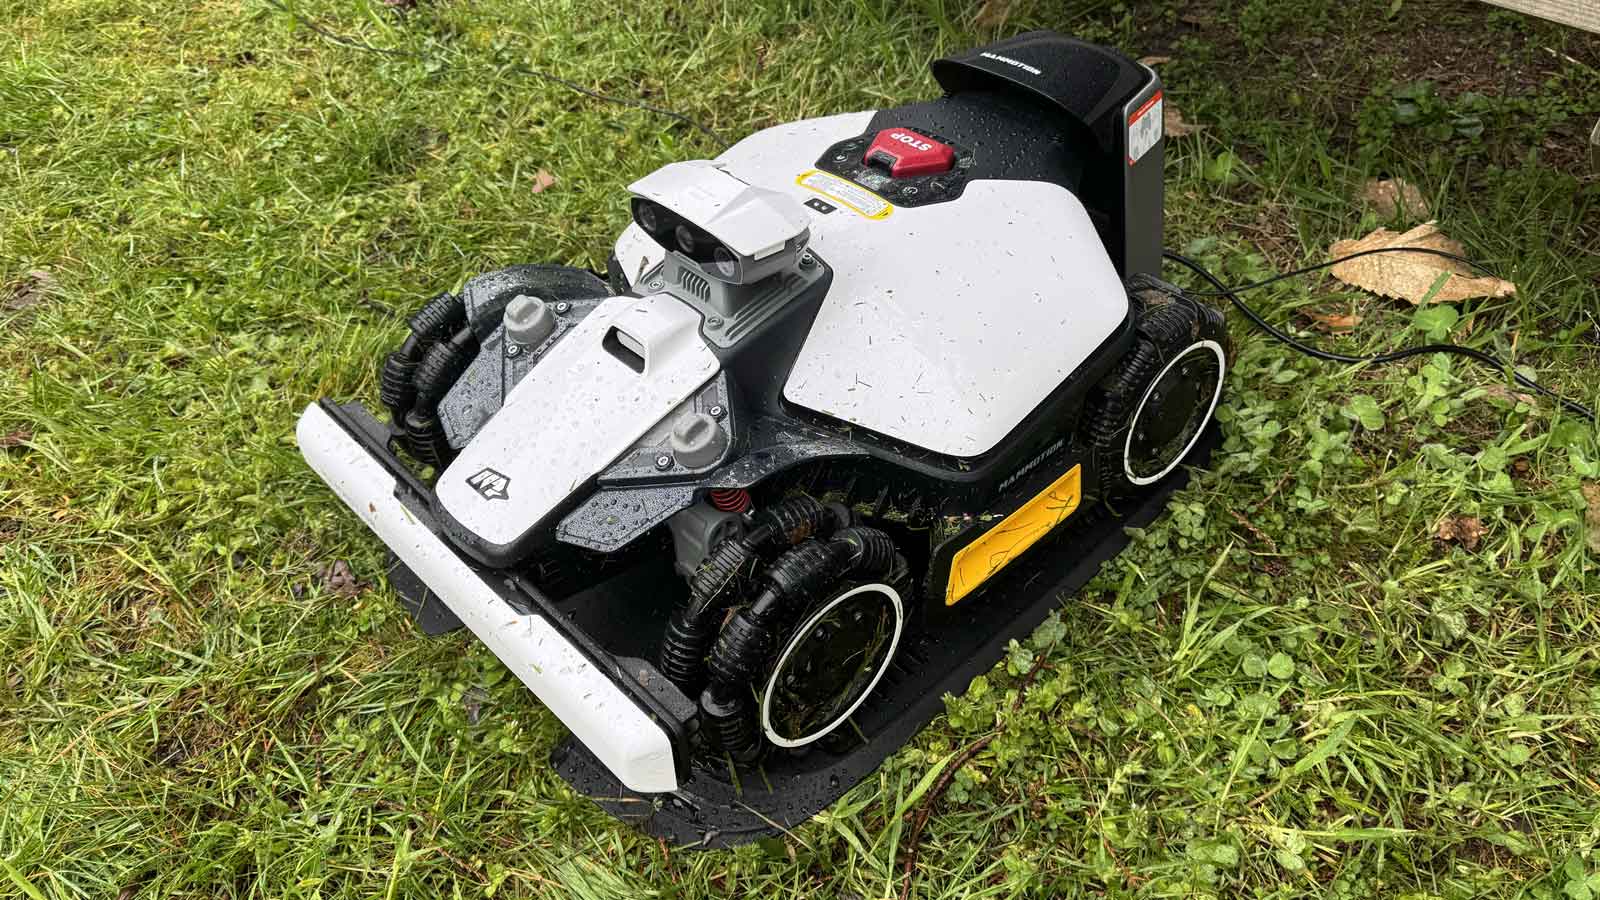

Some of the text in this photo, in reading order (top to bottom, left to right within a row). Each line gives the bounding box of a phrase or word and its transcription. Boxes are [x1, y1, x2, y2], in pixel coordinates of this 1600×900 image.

[980, 51, 1041, 75] MAMMOTION
[889, 132, 933, 151] STOP
[998, 438, 1063, 493] MAMMOTION
